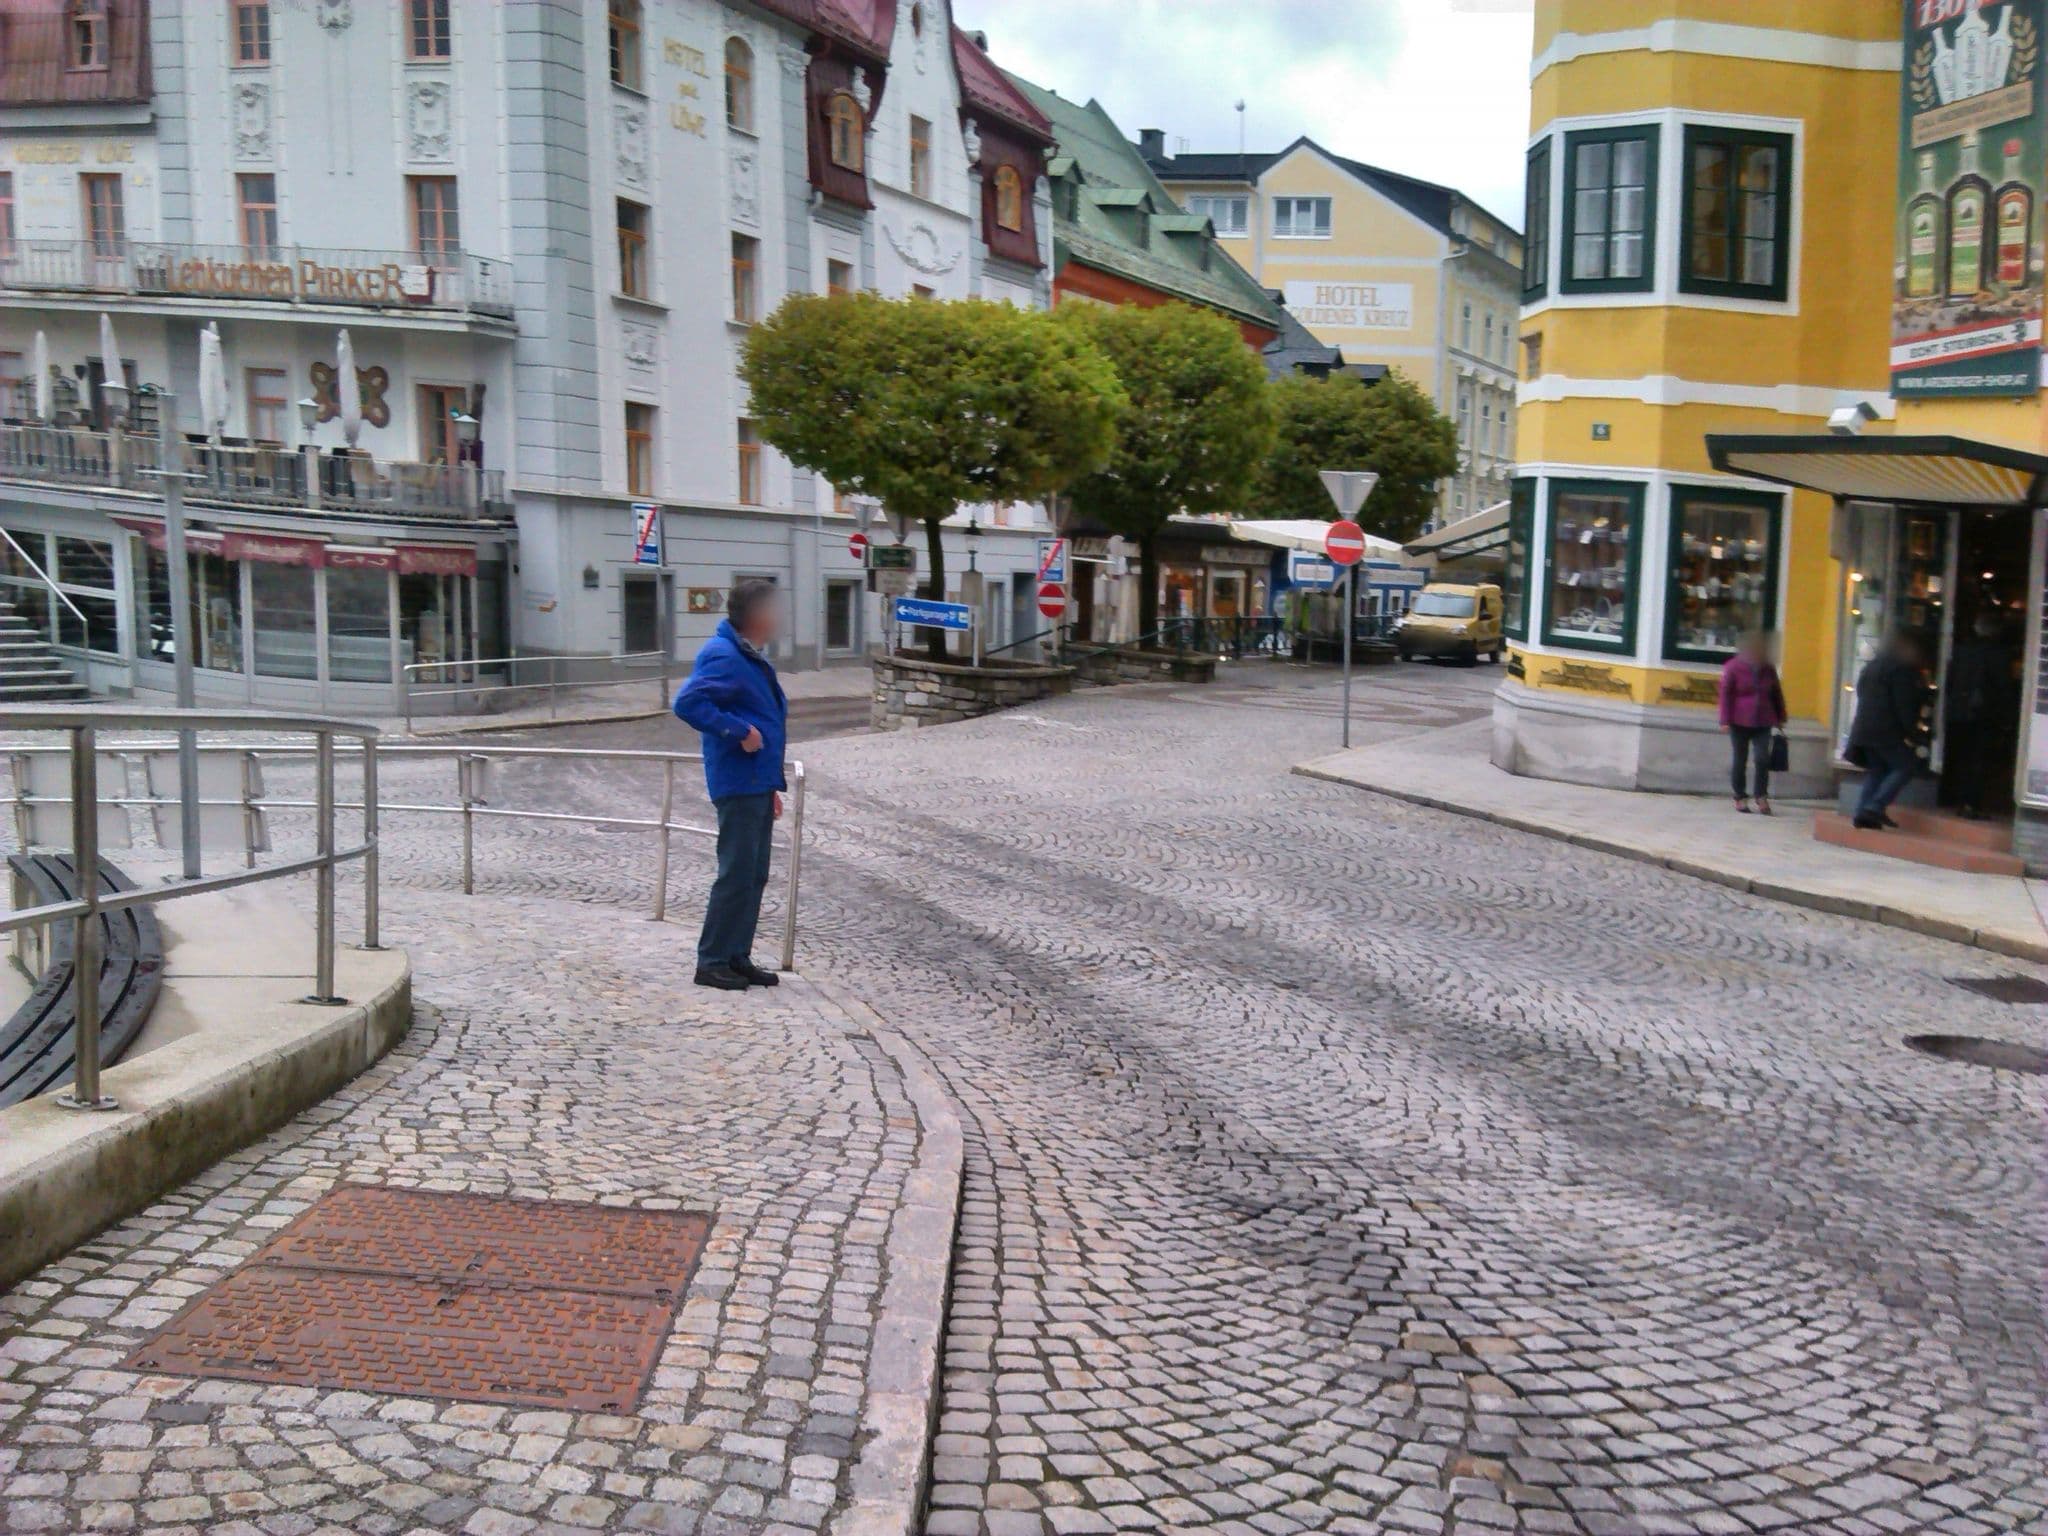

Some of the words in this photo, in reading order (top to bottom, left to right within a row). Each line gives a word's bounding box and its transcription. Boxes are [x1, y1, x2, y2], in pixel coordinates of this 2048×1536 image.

[166, 254, 294, 295] Lebkuchen
[297, 259, 407, 301] PIRKER
[1315, 285, 1382, 307] HOTEL
[1363, 308, 1409, 327] KREUZ
